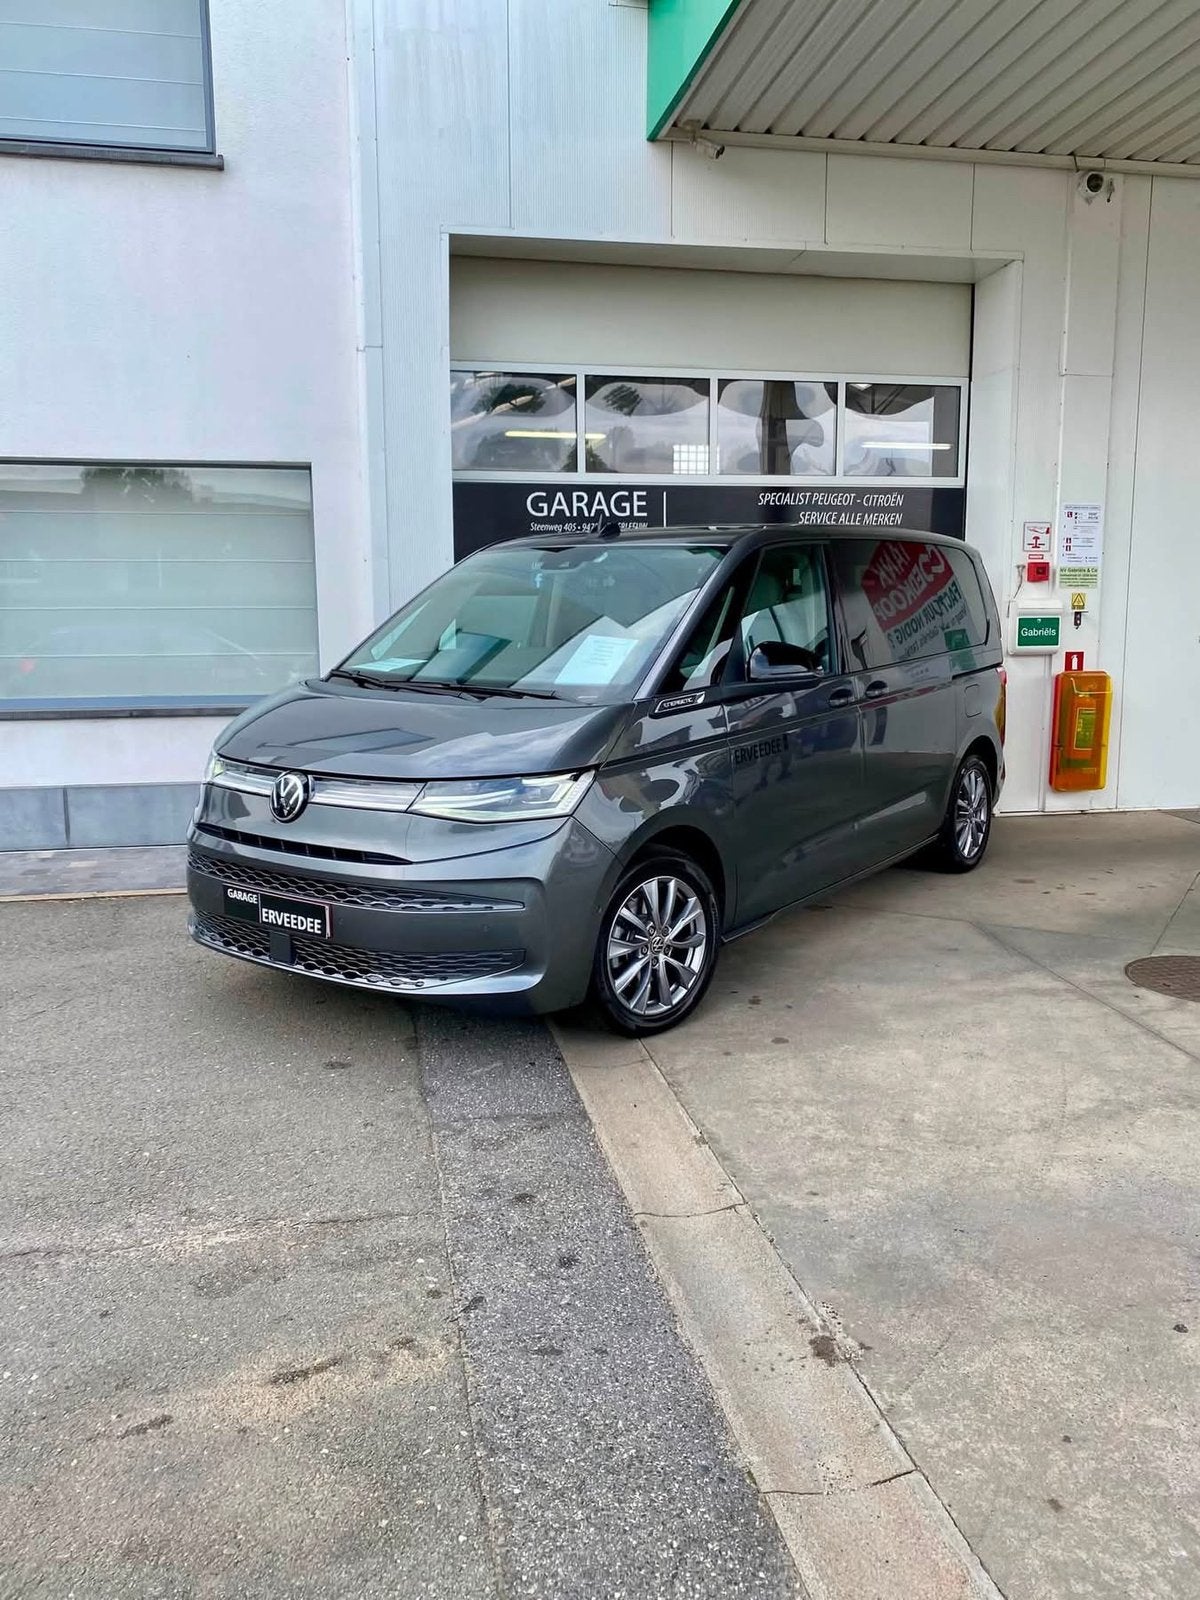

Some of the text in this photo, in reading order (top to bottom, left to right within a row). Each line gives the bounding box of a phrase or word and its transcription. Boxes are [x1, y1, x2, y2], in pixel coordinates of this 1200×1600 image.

[526, 490, 648, 517] GARAGE
[758, 492, 811, 506] SPECIALIST
[812, 492, 856, 506] PEUGEOT
[863, 491, 904, 507] CITROËN
[798, 511, 903, 525] SERVICE ALLE MERKEN
[530, 521, 562, 533] Steenweg
[563, 522, 577, 532] 405
[1021, 627, 1057, 637] Gabriëls
[735, 738, 782, 764] ERVEEDEE
[227, 888, 258, 904] GARAGE
[262, 907, 322, 934] ERVEEDEE
